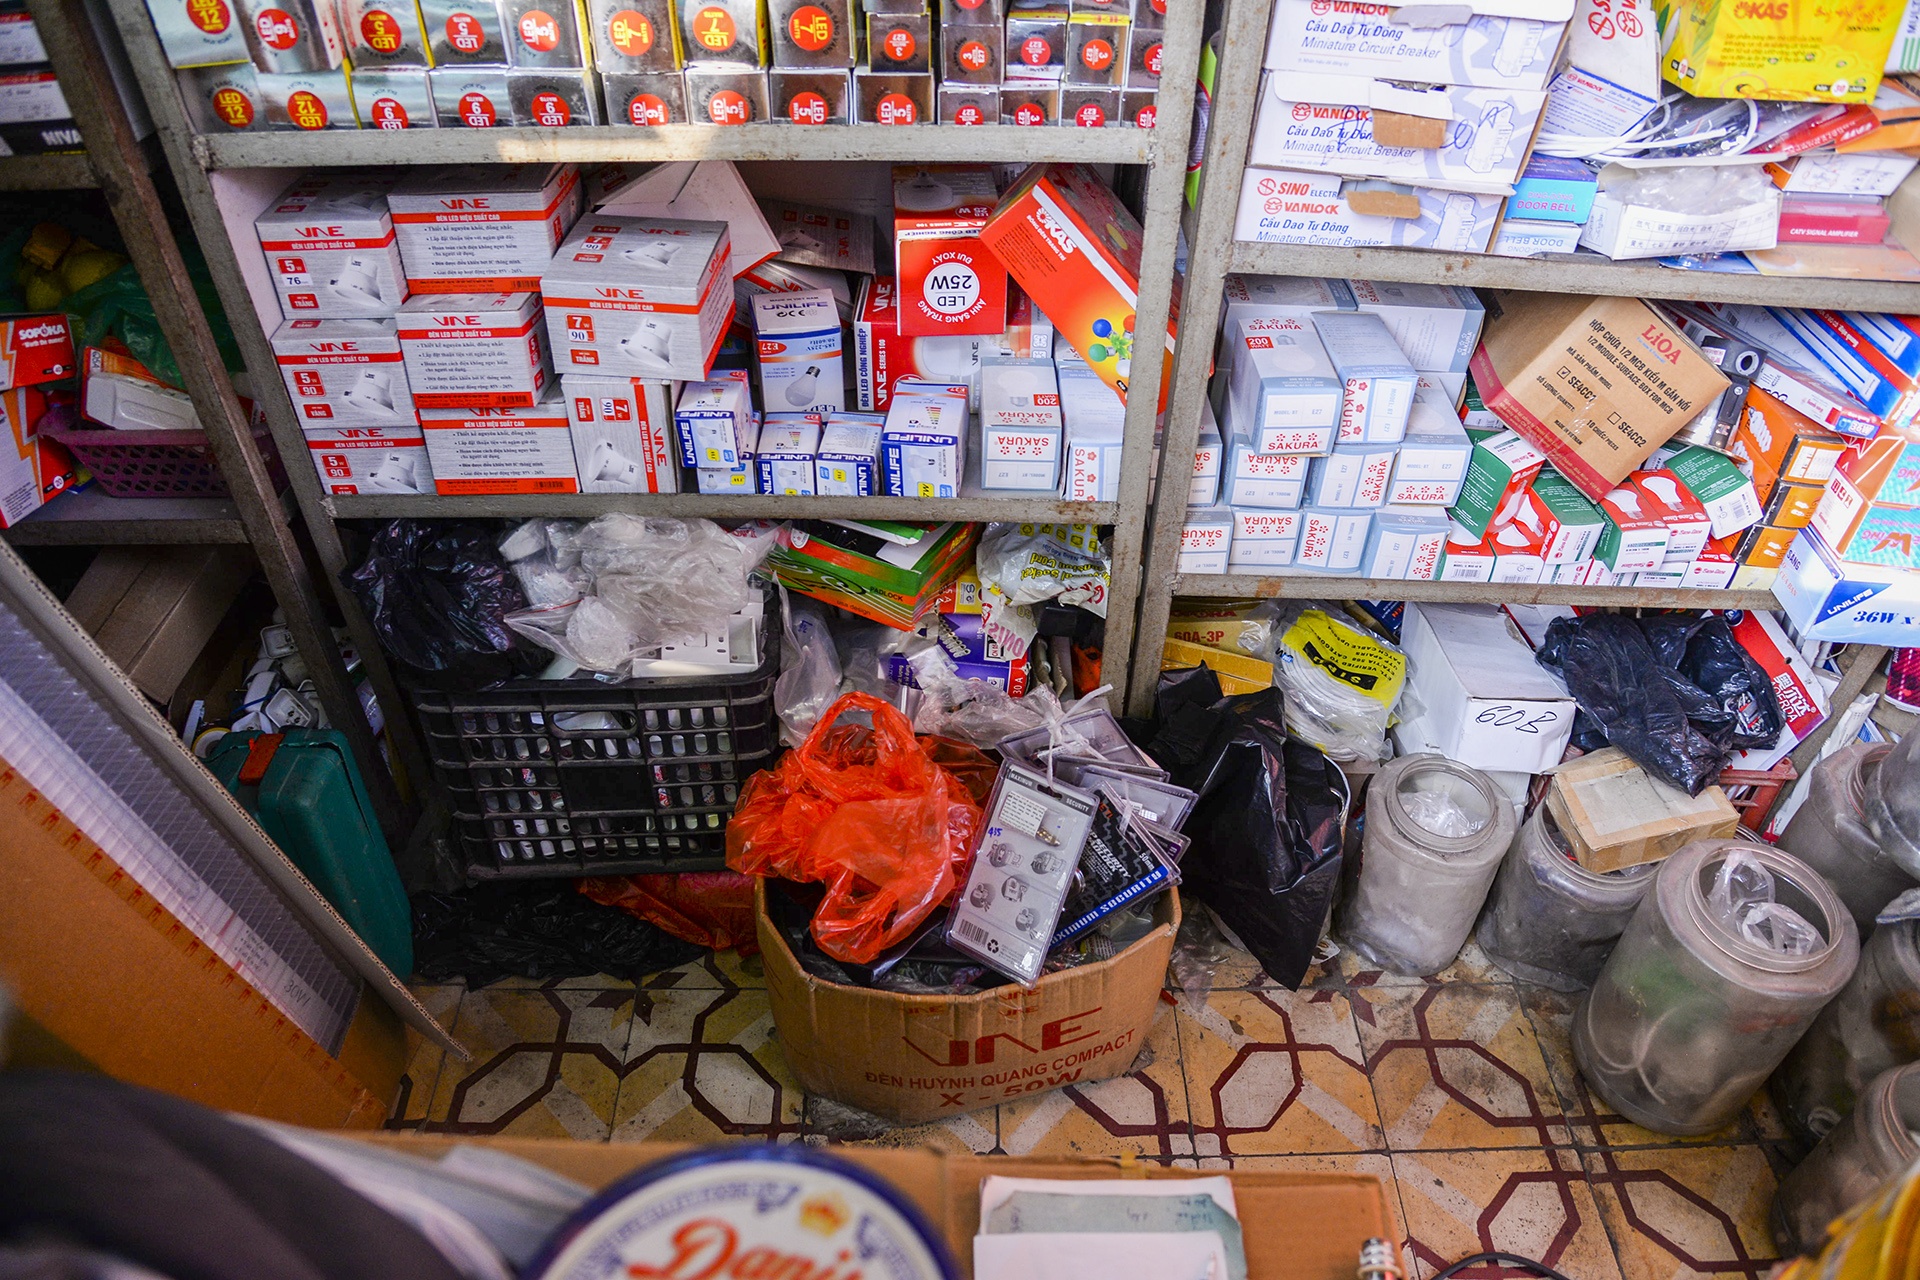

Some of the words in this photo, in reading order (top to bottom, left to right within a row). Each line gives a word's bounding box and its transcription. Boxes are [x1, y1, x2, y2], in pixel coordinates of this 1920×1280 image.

[708, 18, 719, 33] 7
[800, 23, 814, 36] 7
[816, 16, 828, 40] LED
[1305, 19, 1328, 32] Cầu
[1331, 22, 1354, 35] Dao
[1373, 25, 1403, 41] Động
[614, 21, 627, 46] LED
[627, 28, 641, 40] 7
[704, 33, 728, 46] LED
[370, 35, 396, 49] LED
[1301, 37, 1356, 52] Miniature
[1358, 41, 1395, 55] Circuit
[1396, 45, 1441, 58] Breaker
[296, 100, 318, 115] 12
[880, 102, 892, 125] LED
[893, 109, 906, 119] 5
[1313, 107, 1370, 121] VANLOCK
[299, 114, 322, 128] LED
[1278, 182, 1310, 196] SINO
[1310, 190, 1340, 198] ELECTR
[440, 199, 490, 210] VNE
[1284, 202, 1339, 215] VANLOCK
[1517, 200, 1548, 210] DOOR
[1550, 202, 1577, 213] BELL
[295, 226, 344, 238] VNE
[1260, 217, 1280, 228] Cầu
[1283, 219, 1304, 230] Dao
[1308, 220, 1319, 233] Tự
[1321, 222, 1349, 234] Động
[1504, 235, 1531, 245] BELL
[1828, 230, 1859, 238] AMPLIFIER
[1533, 236, 1564, 247] DOOR
[958, 252, 973, 265] ĐUI
[285, 260, 294, 272] 5
[287, 276, 301, 285] 76
[931, 275, 972, 290] 25W
[595, 288, 645, 300] VNE
[762, 301, 828, 311] UNILIFE
[938, 296, 966, 307] LED
[573, 316, 583, 328] 7
[1249, 323, 1302, 331] SAKURA
[571, 330, 585, 341] 90
[1249, 337, 1268, 346] 200
[310, 342, 359, 352] VNE
[762, 343, 779, 351] E27
[1642, 324, 1681, 365] LiOA
[1588, 319, 1605, 334] HỘP
[1619, 346, 1632, 359] 1/2
[1629, 355, 1646, 371] MCB
[1657, 381, 1667, 390] M
[861, 359, 870, 377] CÔNG
[1587, 335, 1598, 347] 1/2
[1595, 344, 1619, 366] MODULE
[1616, 362, 1641, 385] SURFACE
[1638, 381, 1651, 394] BOX
[1649, 392, 1661, 405] FOR
[1659, 402, 1674, 414] MCB
[300, 373, 310, 384] 5
[862, 378, 870, 391] LED
[302, 386, 317, 395] 90
[877, 371, 887, 406] VNE
[1568, 376, 1597, 403] SE4CC1
[1037, 398, 1058, 406] 200
[1341, 378, 1357, 438] SAKURA
[1554, 419, 1565, 430] MADE
[1587, 419, 1595, 428] 10
[888, 434, 952, 444] UNILIFE
[1618, 421, 1648, 448] SE4CC2
[685, 422, 696, 465] UNILIFE
[997, 436, 1049, 447] SAKURA
[1268, 440, 1319, 450] SAKURA
[1397, 493, 1445, 501] SAKURA
[1244, 517, 1292, 525] SAKURA
[1030, 553, 1057, 568] Cord
[1021, 566, 1059, 581] Socket
[869, 586, 904, 602] PADLOCK
[1853, 611, 1899, 624] 36W
[1174, 630, 1225, 643] 60A-3P
[1342, 661, 1377, 671] VERIFIED
[1013, 676, 1023, 685] A
[1012, 684, 1022, 695] 30
[1009, 772, 1034, 787] MAXIMUM
[1065, 797, 1090, 812] SECURITY
[1139, 852, 1155, 871] 50mm
[864, 1071, 903, 1088] ĐÈN
[909, 1073, 975, 1091] HUỲNH
[981, 1062, 1048, 1087] QUANG
[1052, 1028, 1136, 1071] COMPACT
[939, 1092, 965, 1108] X
[1003, 1067, 1084, 1096] 50W
[622, 1216, 866, 1280] Dani
